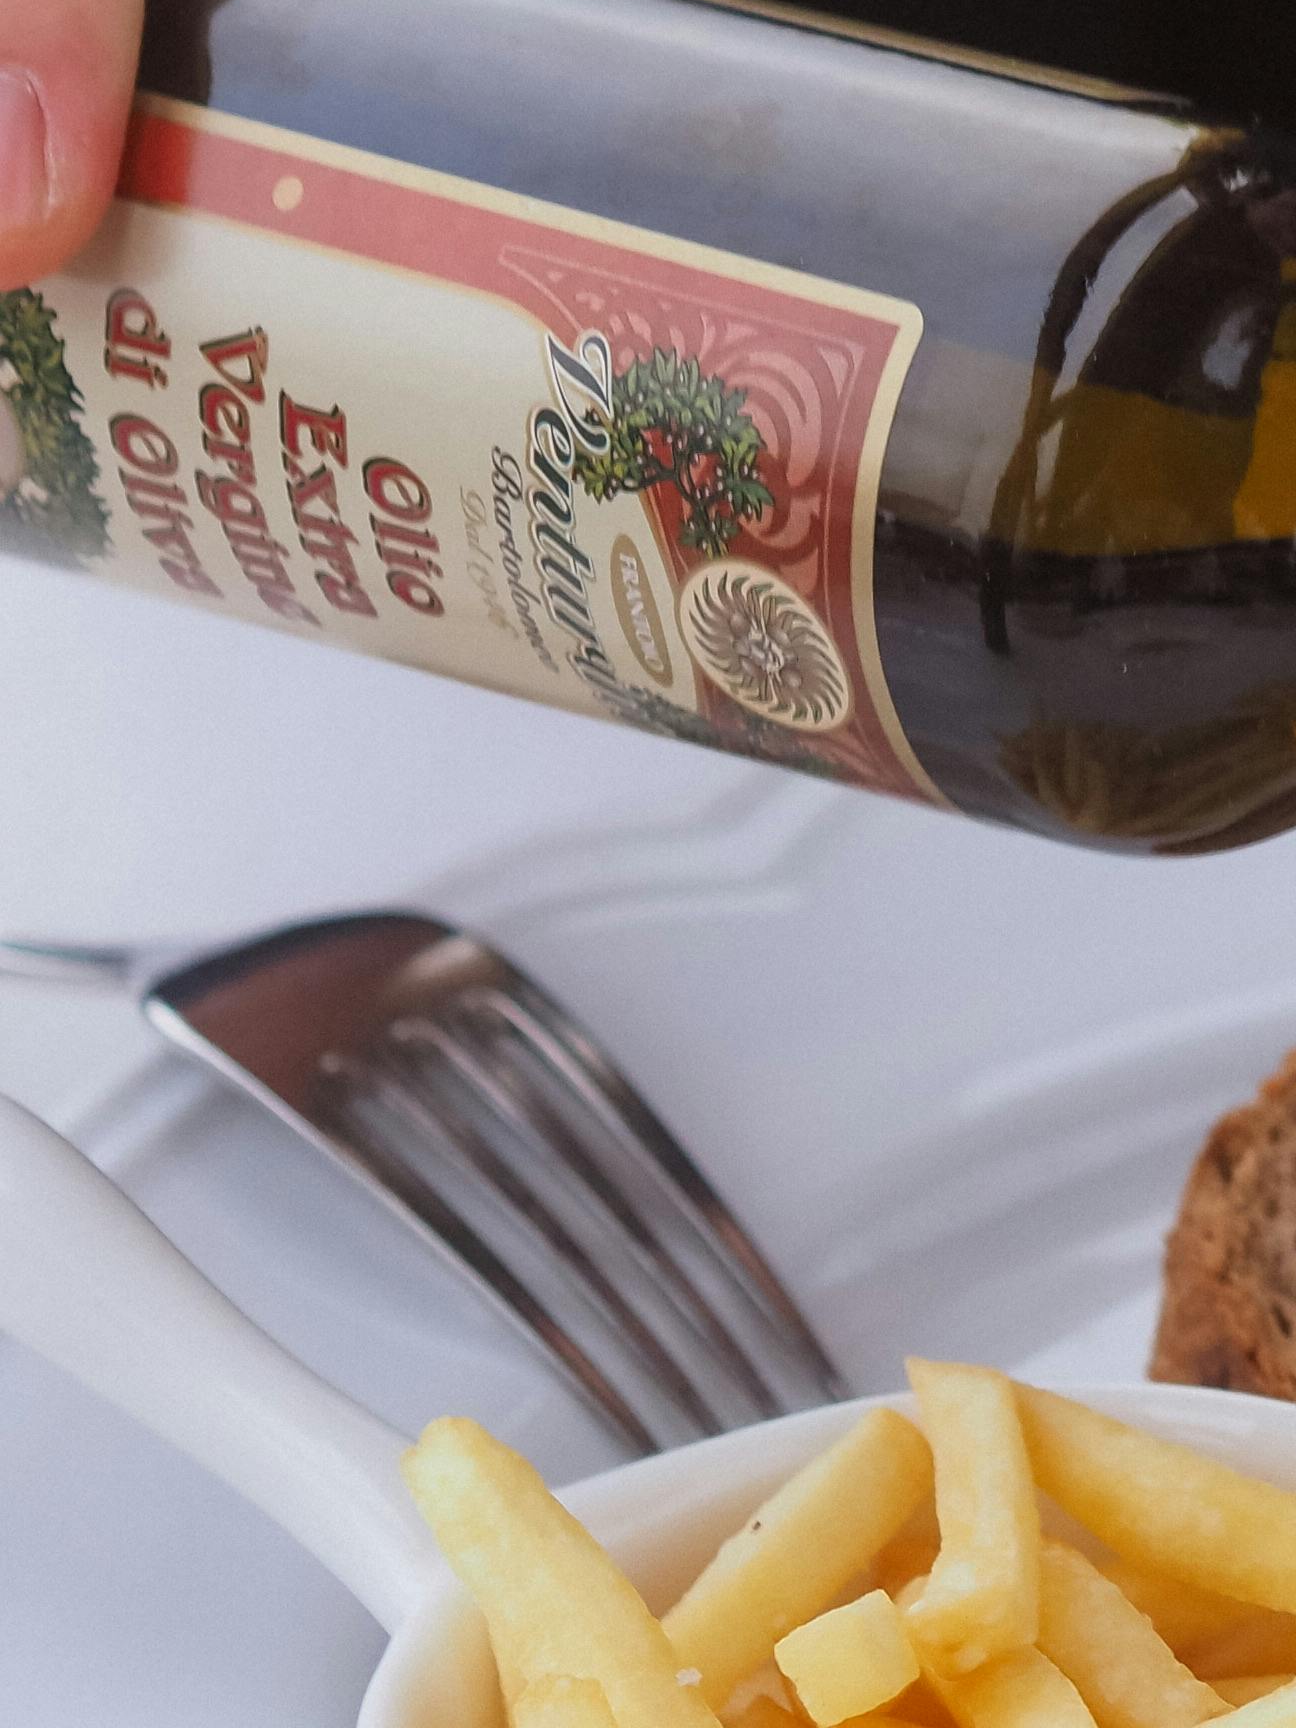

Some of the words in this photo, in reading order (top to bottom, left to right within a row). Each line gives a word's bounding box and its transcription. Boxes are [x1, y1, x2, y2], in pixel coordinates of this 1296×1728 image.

[104, 288, 171, 390] di
[108, 411, 224, 597] Oliva
[279, 387, 379, 617] Extra
[362, 456, 444, 614] Olio
